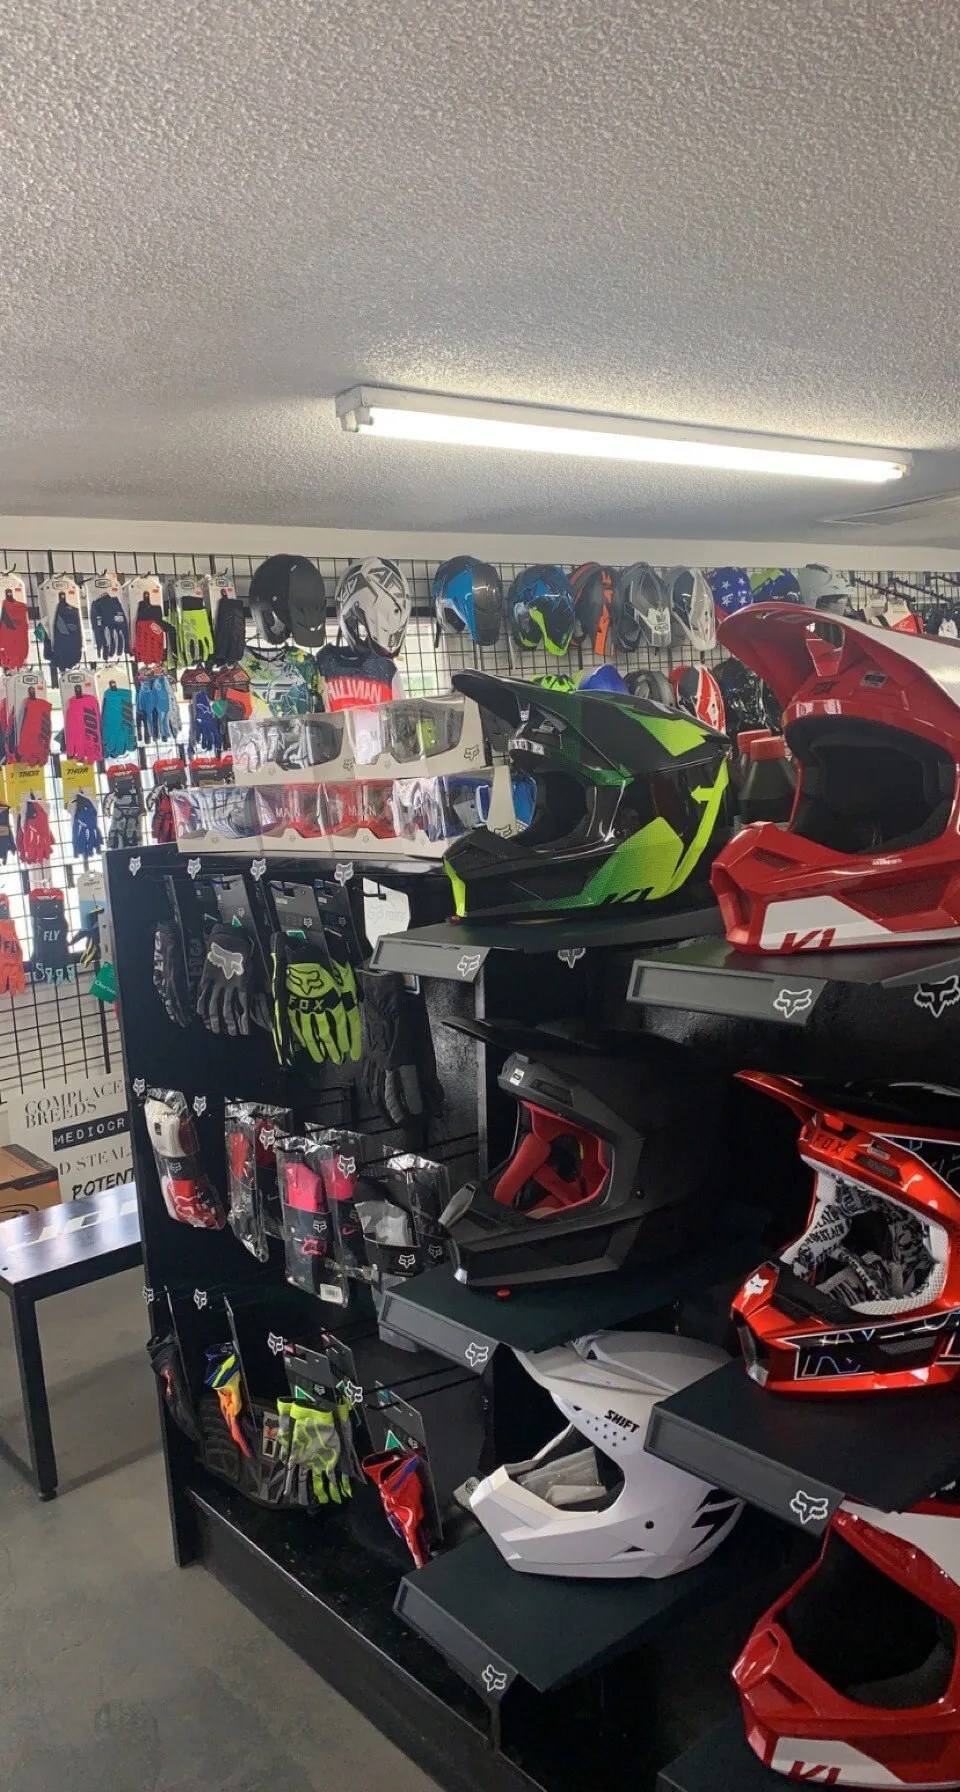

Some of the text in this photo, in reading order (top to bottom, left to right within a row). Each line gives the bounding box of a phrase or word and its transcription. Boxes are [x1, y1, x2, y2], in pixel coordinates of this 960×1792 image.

[20, 770, 40, 778] THOR
[66, 767, 89, 775] THOR
[43, 930, 60, 941] FLY
[288, 993, 325, 1011] FOX
[24, 1079, 123, 1116] COMPLACE
[26, 1100, 97, 1129] BREEDS
[54, 1117, 126, 1147] MEDIOCR
[814, 1133, 846, 1155] FOX
[604, 1409, 640, 1433] SHIFT
